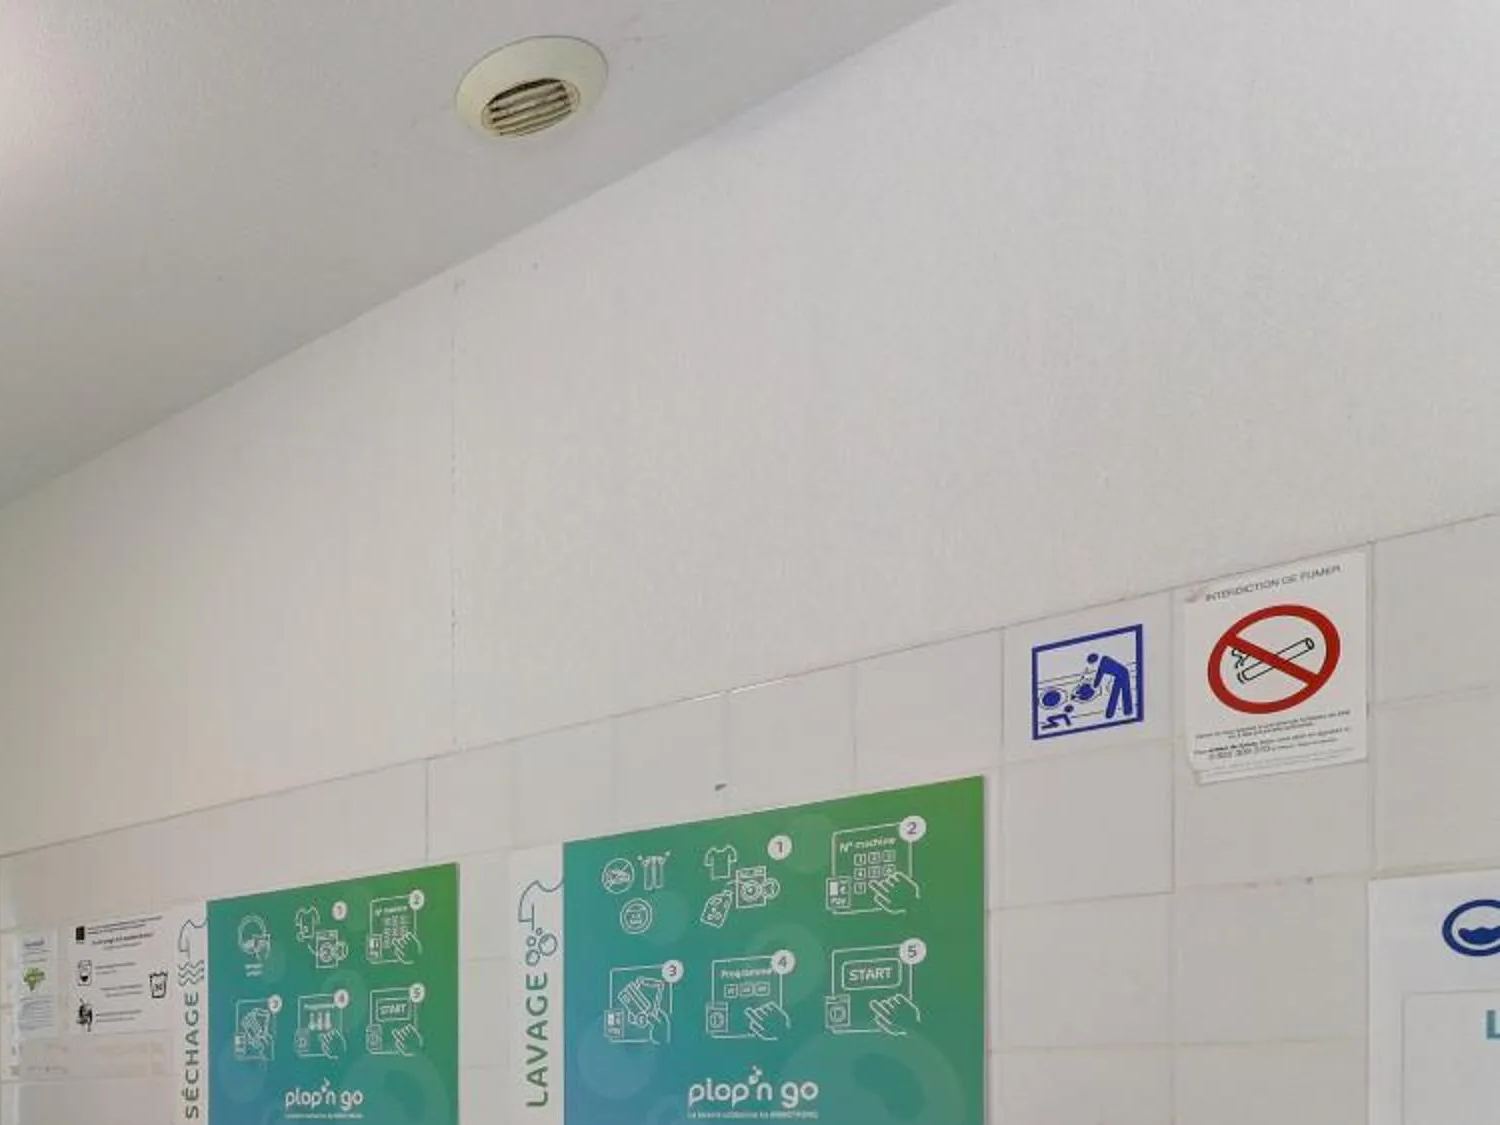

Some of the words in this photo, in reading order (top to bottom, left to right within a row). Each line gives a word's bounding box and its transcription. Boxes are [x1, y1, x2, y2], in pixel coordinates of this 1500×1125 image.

[1205, 578, 1280, 601] INTERDICTION
[1282, 574, 1298, 585] DE
[1300, 564, 1341, 580] FUMER
[907, 822, 917, 834] 2
[849, 967, 892, 982] START
[380, 1003, 407, 1015] START
[526, 972, 548, 1107] LAVAGE
[182, 992, 199, 1119] SÉCHAGE
[340, 1089, 363, 1111] go
[781, 1081, 819, 1108] go
